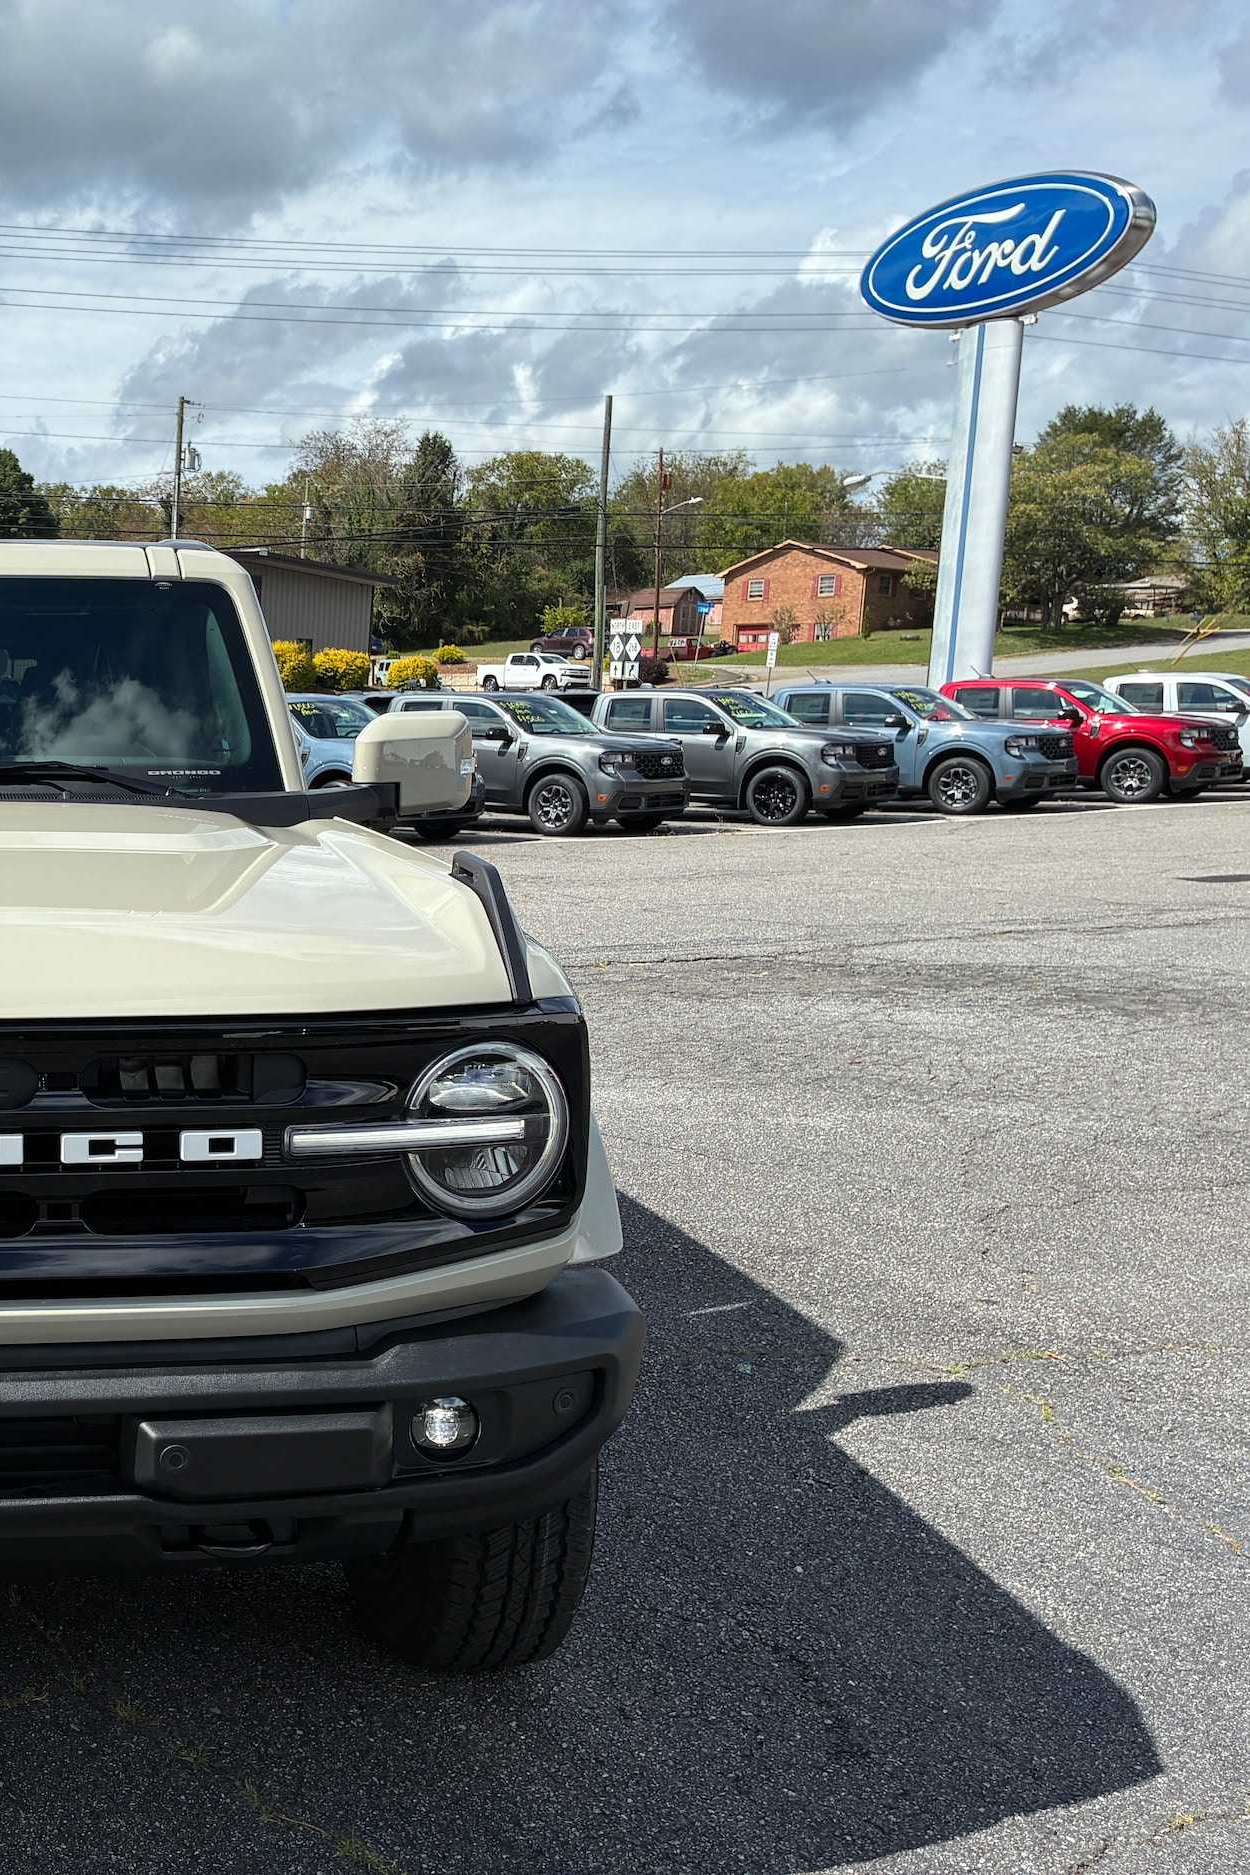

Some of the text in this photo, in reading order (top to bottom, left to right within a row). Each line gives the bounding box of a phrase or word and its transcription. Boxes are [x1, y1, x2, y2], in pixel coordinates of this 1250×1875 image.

[905, 202, 1066, 301] Ford
[628, 622, 640, 630] EAST
[613, 642, 621, 654] 18
